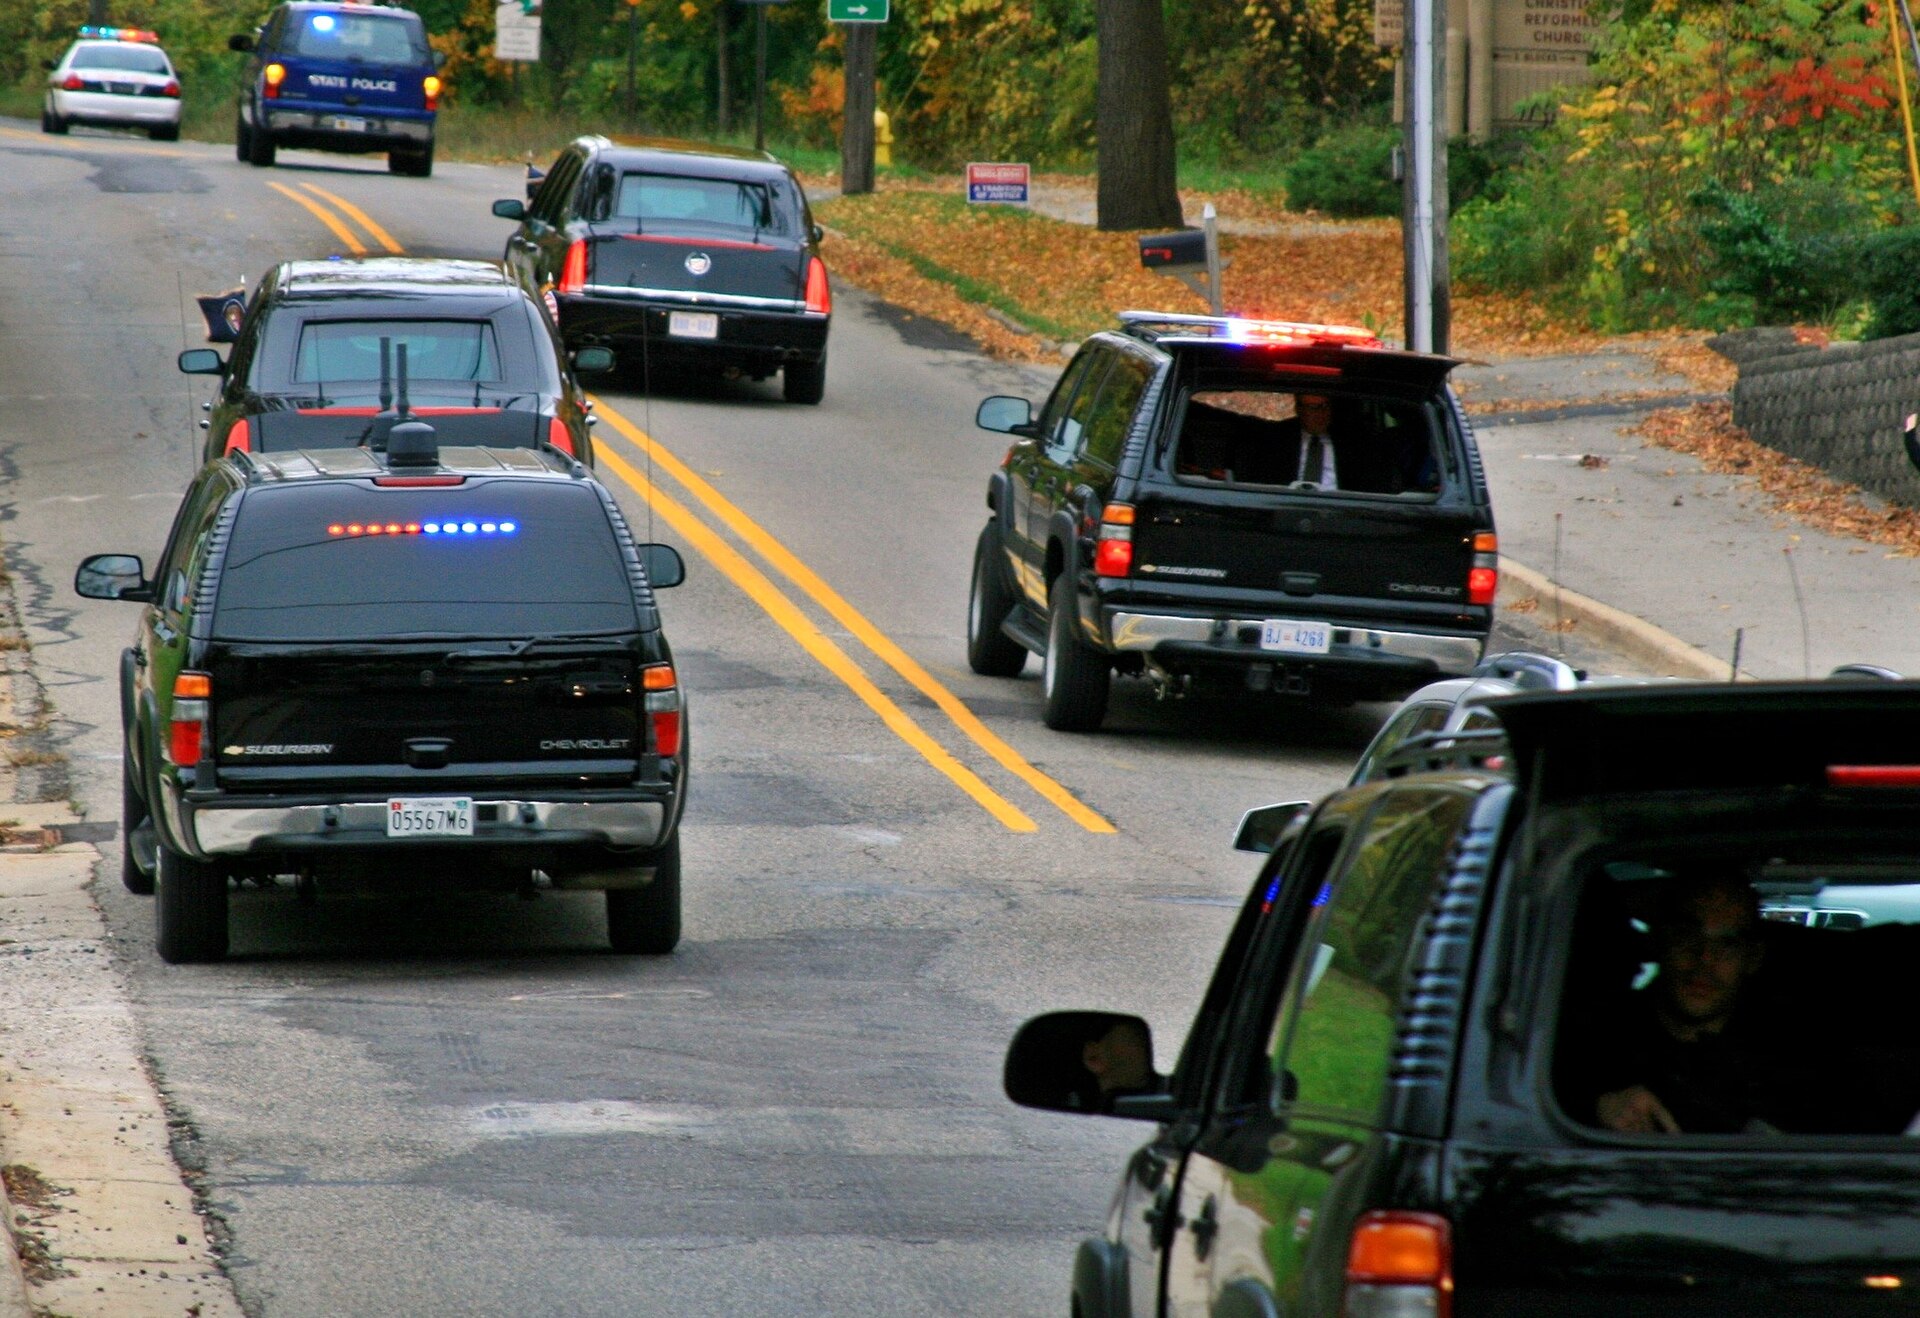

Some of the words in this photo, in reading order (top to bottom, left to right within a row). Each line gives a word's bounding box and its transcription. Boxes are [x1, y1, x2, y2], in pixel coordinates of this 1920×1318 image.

[1525, 13, 1600, 26] REFORMED
[309, 75, 347, 88] STATE
[352, 78, 397, 92] POLICE
[1156, 565, 1227, 578] SUBURBAN
[1389, 583, 1462, 596] CHEVROLET
[245, 744, 333, 755] SUBURBAN
[540, 739, 630, 749] CHEVROLET
